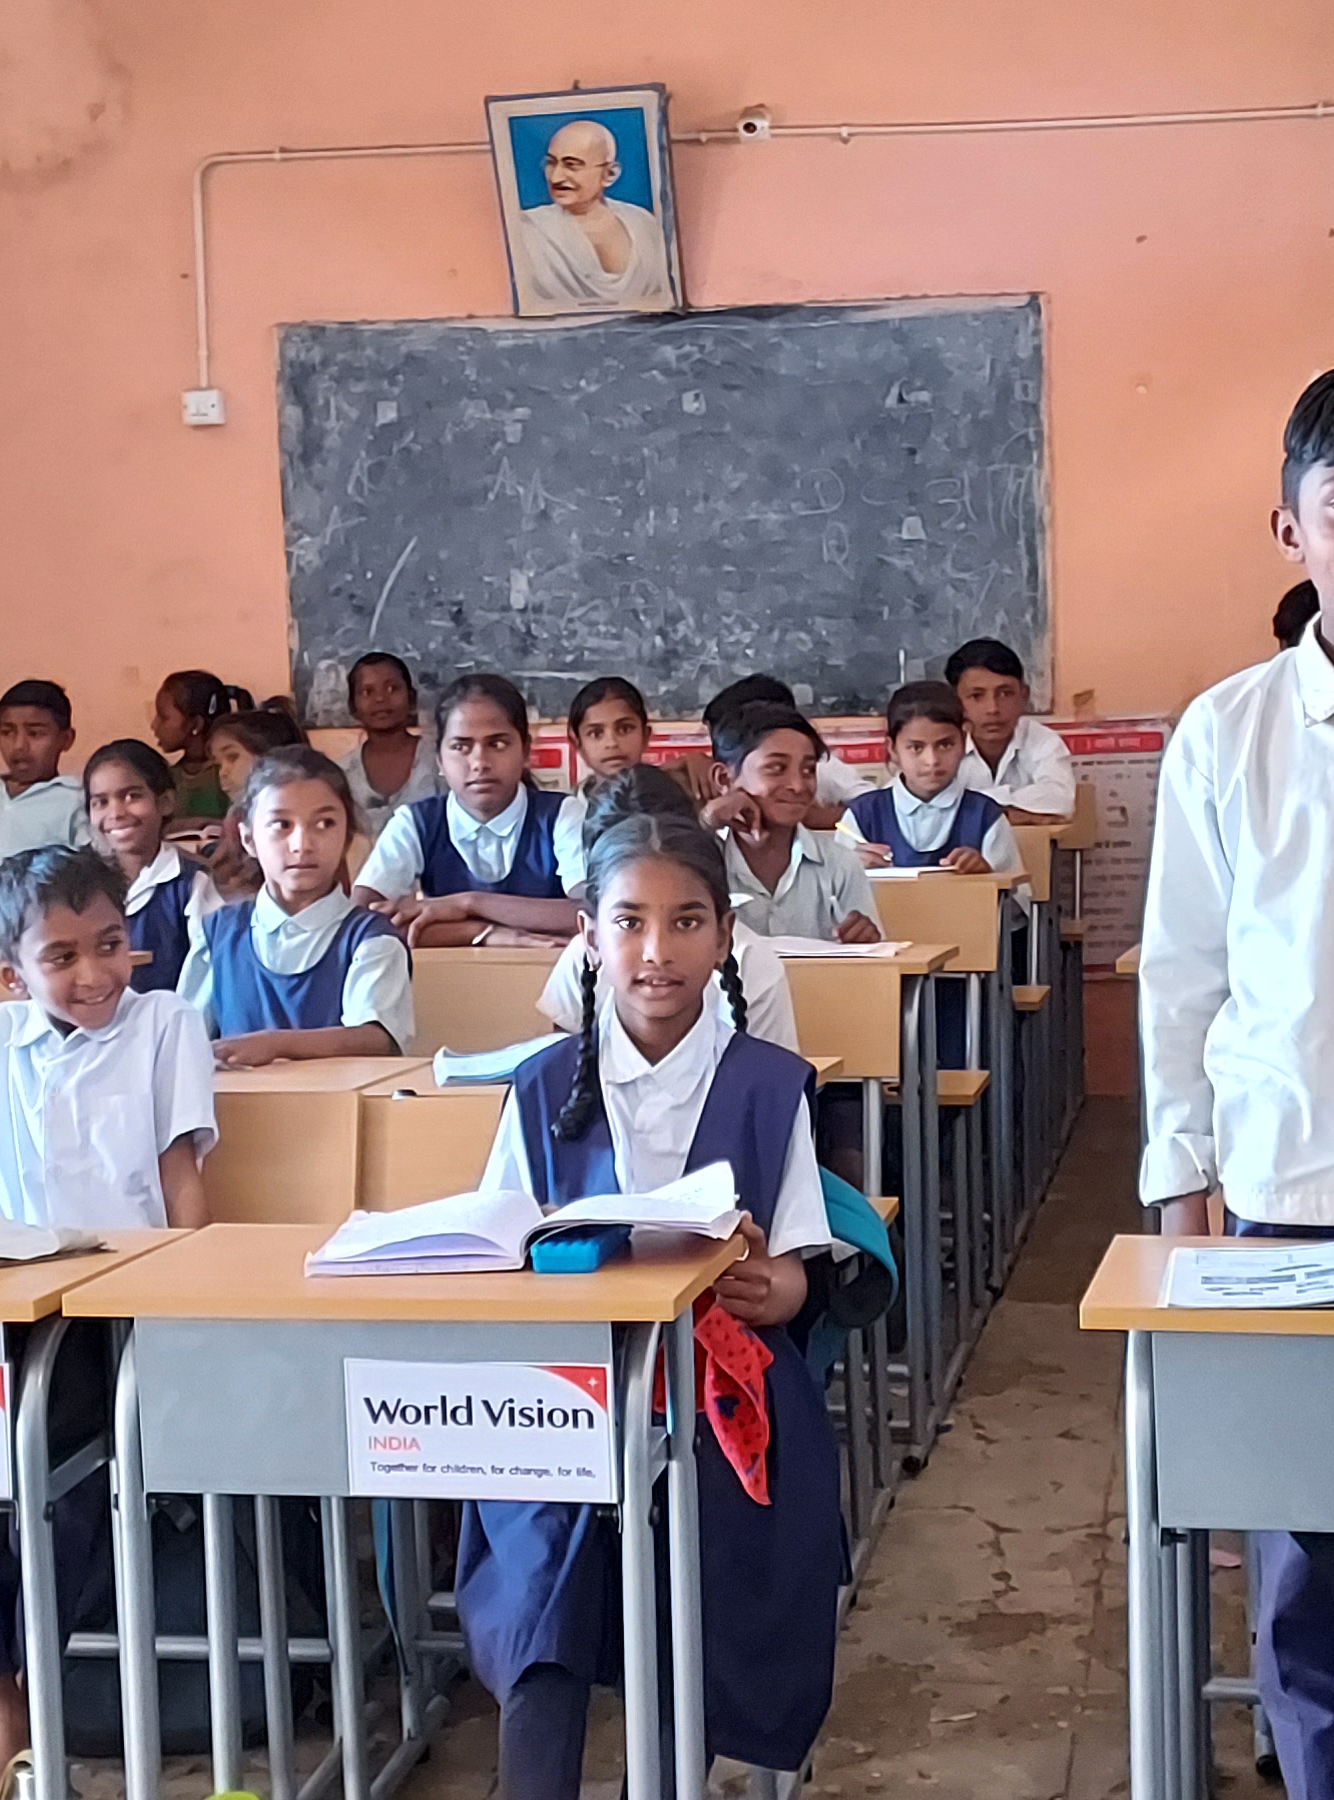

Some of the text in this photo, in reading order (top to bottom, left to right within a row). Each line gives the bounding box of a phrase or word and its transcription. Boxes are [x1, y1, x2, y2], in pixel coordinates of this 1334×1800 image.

[363, 1395, 595, 1429] World Vision
[368, 1436, 421, 1452] INDIA
[370, 1461, 418, 1474] Together
[422, 1462, 437, 1474] for
[490, 1464, 505, 1475] for
[557, 1466, 572, 1477] for
